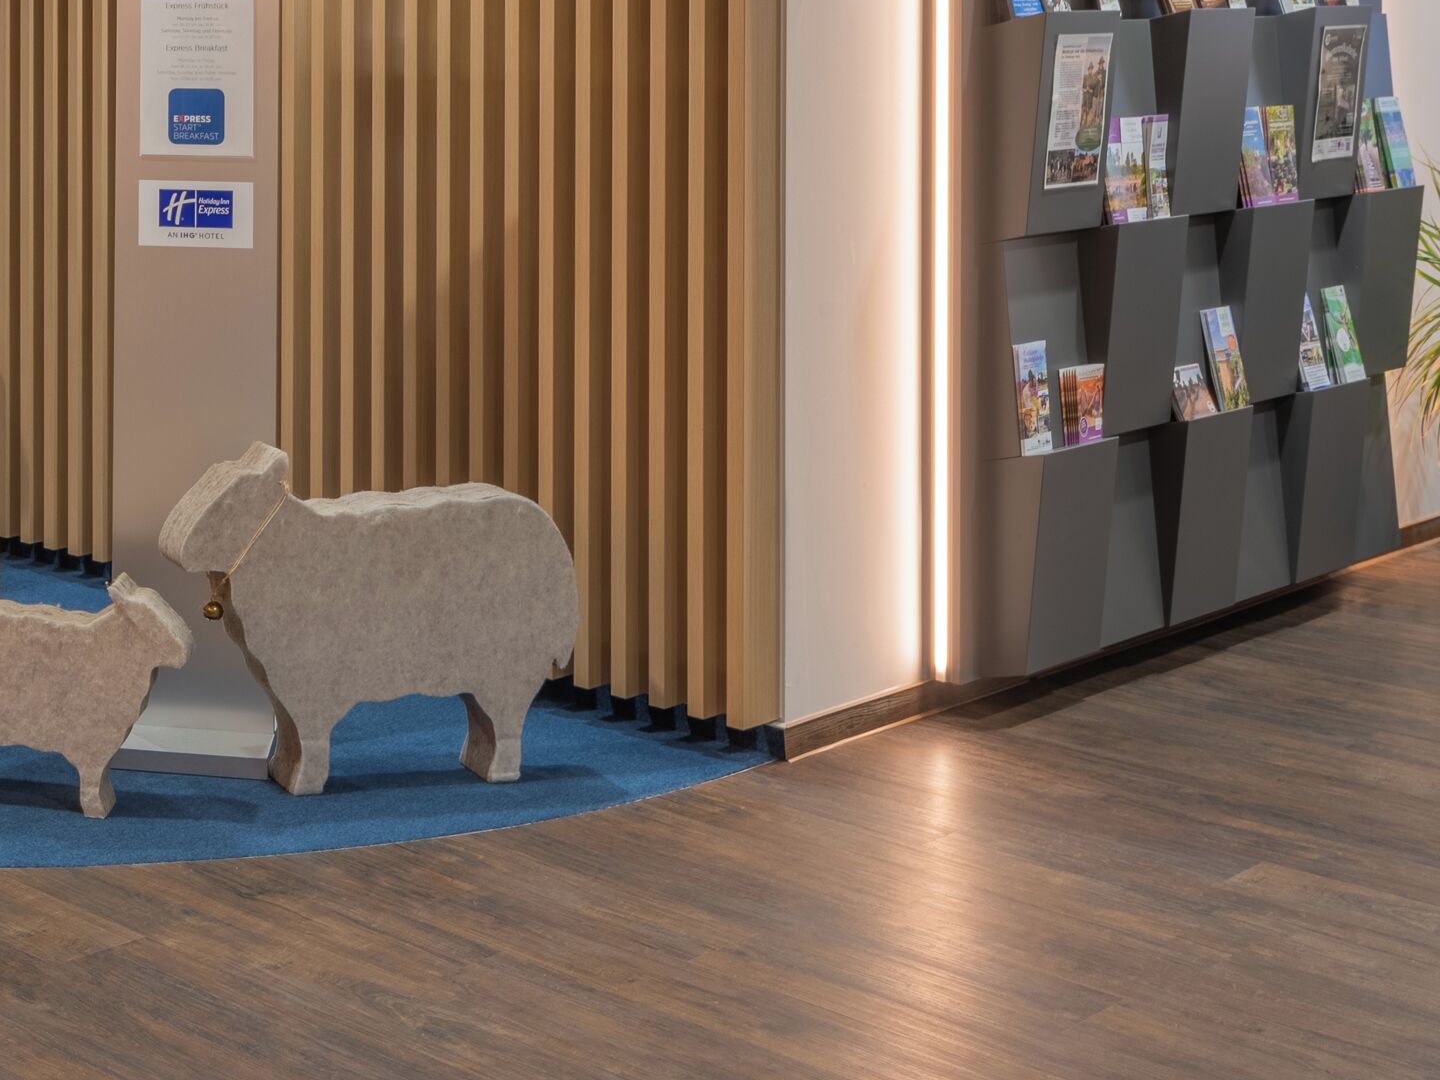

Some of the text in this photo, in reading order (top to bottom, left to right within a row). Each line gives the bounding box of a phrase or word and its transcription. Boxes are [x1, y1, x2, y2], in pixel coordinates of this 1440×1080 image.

[173, 132, 219, 140] BREAKFAST
[198, 197, 230, 206] Holiday Inn
[198, 205, 230, 216] Express
[167, 231, 179, 239] AN
[198, 232, 225, 240] HOTEL
